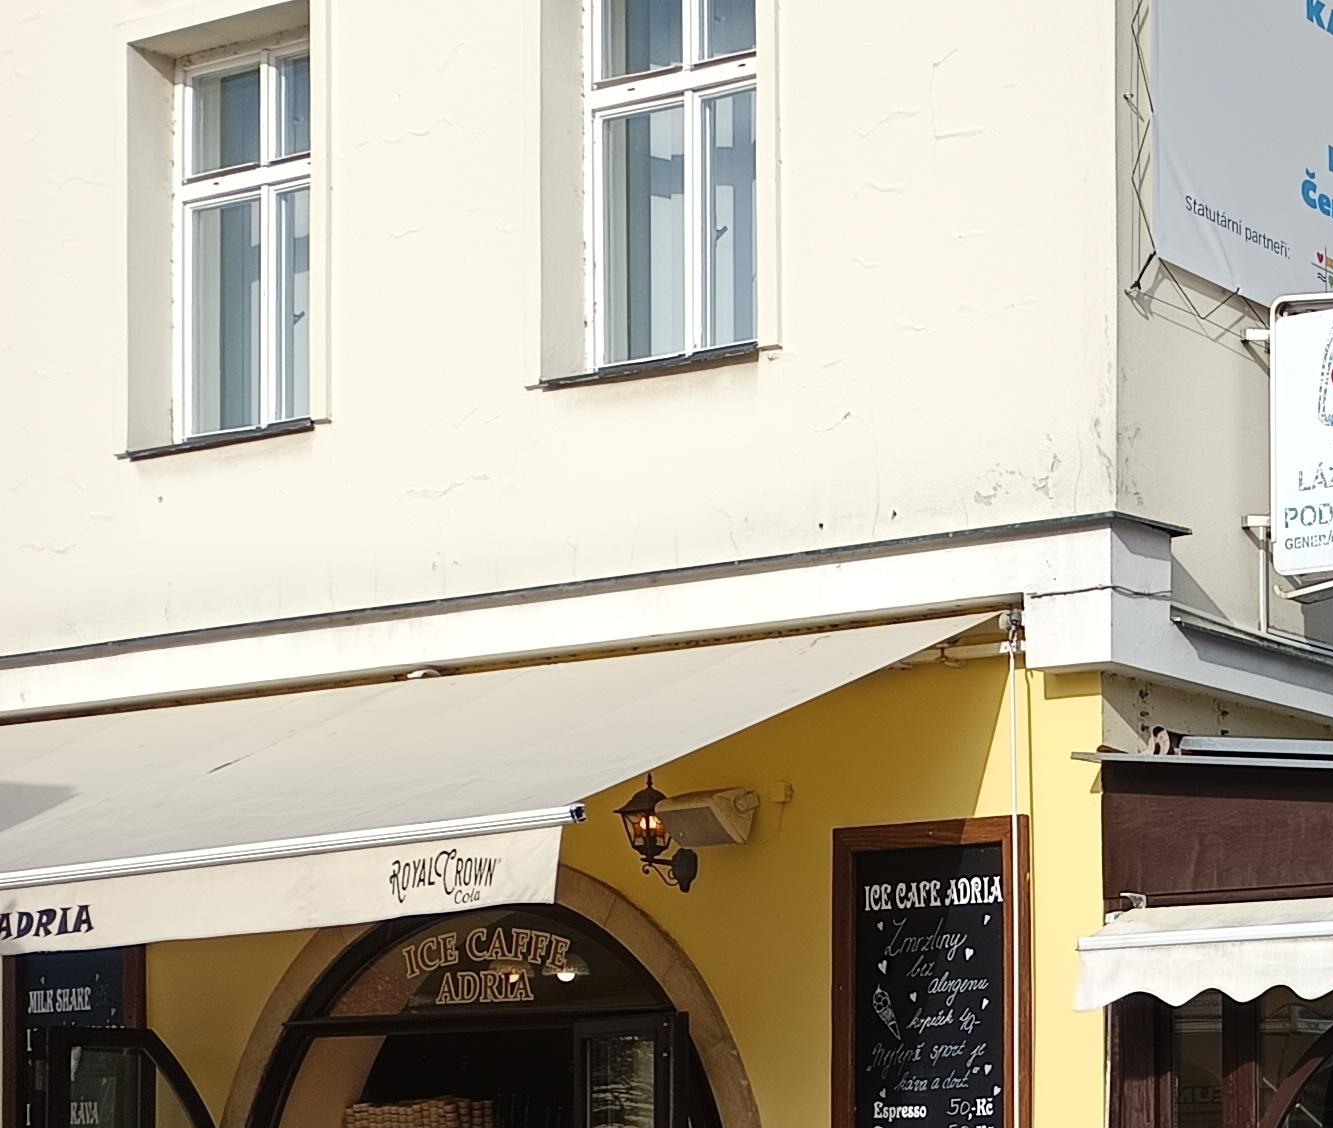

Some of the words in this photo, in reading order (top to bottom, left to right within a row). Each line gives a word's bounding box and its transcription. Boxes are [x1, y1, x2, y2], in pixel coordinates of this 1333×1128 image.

[1185, 195, 1242, 235] Statutární
[1245, 226, 1290, 261] partneři:
[454, 887, 480, 905] Cola
[864, 884, 892, 911] ICE
[895, 880, 941, 909] CAFE
[945, 875, 1004, 906] ADRIA
[0, 904, 95, 941] ADRIA
[402, 931, 459, 979] ICE
[465, 927, 571, 969] CAFFE
[28, 989, 54, 1014] MILK
[56, 987, 91, 1012] SHAKE
[435, 969, 534, 1005] ADRIA
[873, 1101, 927, 1122] Espresso
